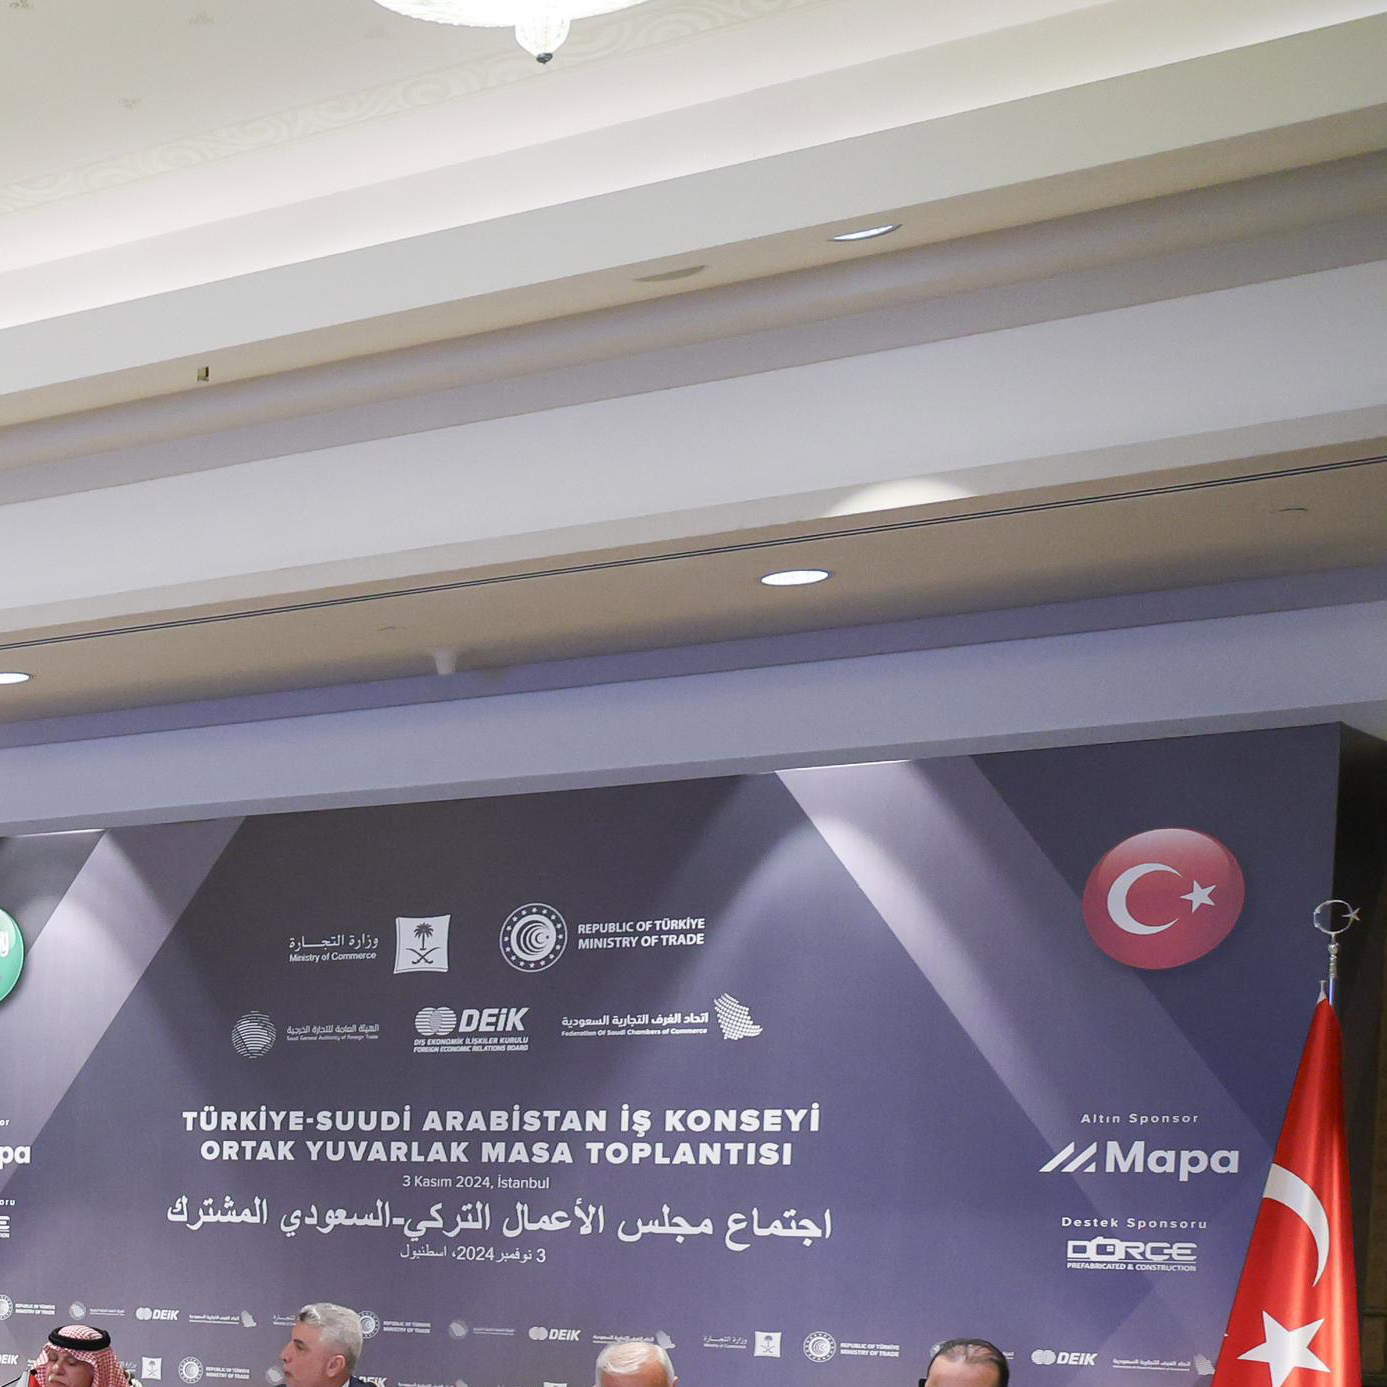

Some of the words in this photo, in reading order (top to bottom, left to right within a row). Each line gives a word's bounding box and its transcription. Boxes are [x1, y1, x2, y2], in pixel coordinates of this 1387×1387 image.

[578, 922, 633, 934] REPUBLIC
[636, 920, 653, 932] OF
[654, 917, 705, 931] TÜRKİYE
[349, 933, 379, 950] وزارة
[578, 936, 637, 950] MINISTRY
[641, 936, 659, 947] OF
[660, 934, 705, 946] TRADE
[289, 953, 320, 963] Ministry
[321, 952, 329, 960] of
[331, 952, 377, 961] Commerce
[561, 1015, 609, 1028] السعودية
[182, 1104, 411, 1132] TÜRKİYE-SUUDİ
[422, 1104, 607, 1132] ARABİSTAN
[620, 1103, 652, 1137] İŞ
[665, 1102, 820, 1132] KONSEYİ
[1081, 1114, 1121, 1124] Altın
[1129, 1113, 1199, 1126] Sponsor
[200, 1140, 296, 1161] ORTAK
[306, 1141, 470, 1162] YUVARLAK
[481, 1142, 573, 1164] MASA
[585, 1142, 793, 1166] TOPLANTISI
[1105, 1140, 1240, 1182] Mapa
[402, 1176, 411, 1188] 3
[414, 1174, 453, 1188] Kasım
[456, 1175, 494, 1190] 2024,
[497, 1174, 550, 1189] İstanbul
[167, 1194, 268, 1231] المشترك
[502, 1197, 605, 1238] الأعمال
[617, 1203, 714, 1244] مجلس
[724, 1207, 832, 1252] اجتماع
[1061, 1216, 1119, 1228] Destek
[1127, 1217, 1207, 1230] Sponsoru
[535, 1248, 547, 1263] 3
[1067, 1262, 1126, 1271] PREFABRICATED
[1135, 1262, 1197, 1272] CONSTRUCTION
